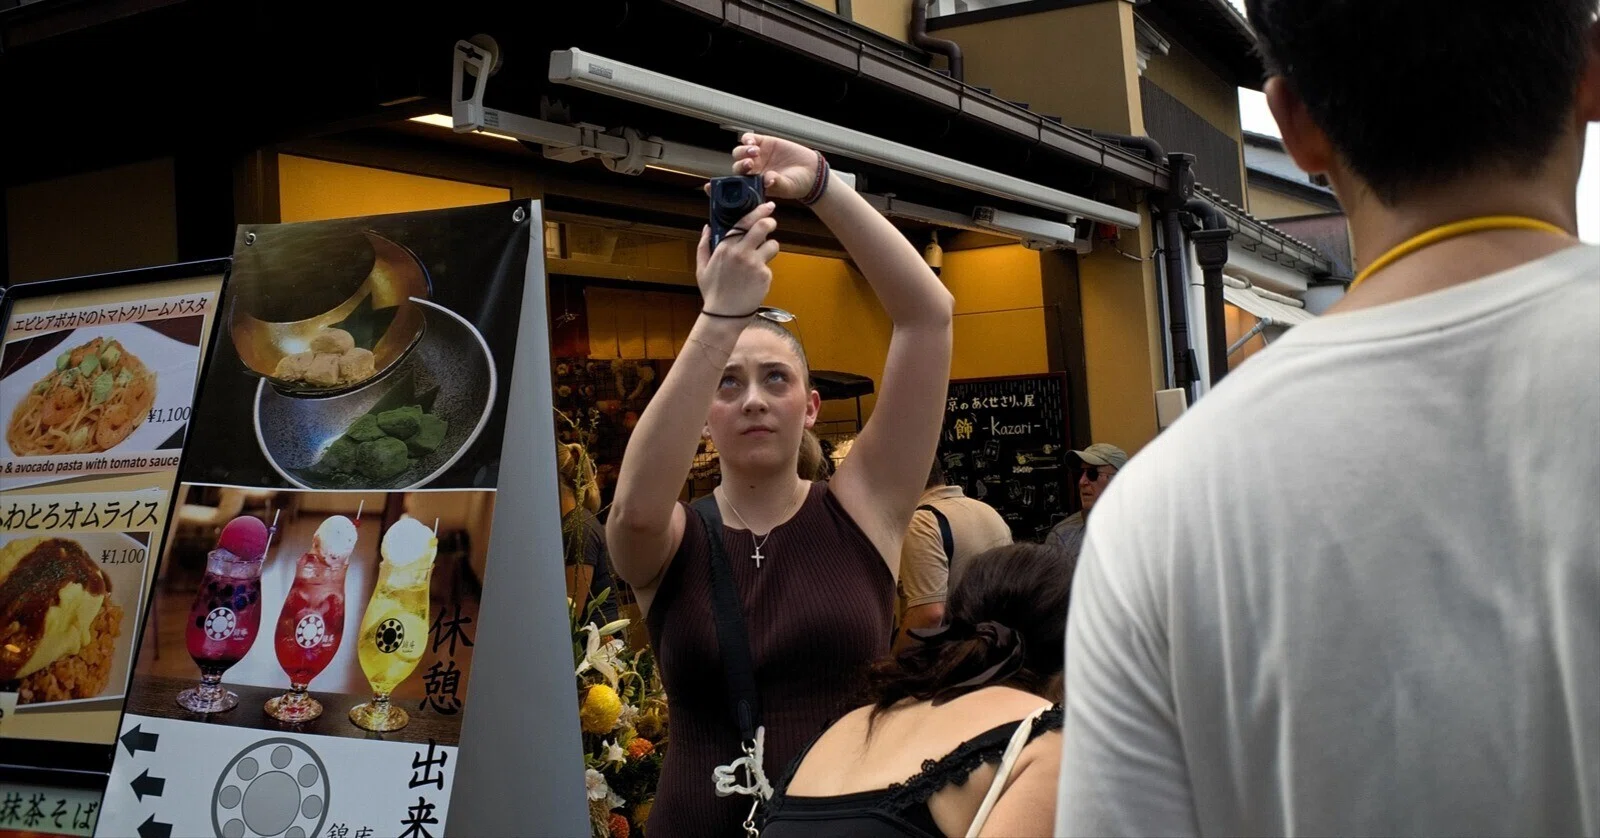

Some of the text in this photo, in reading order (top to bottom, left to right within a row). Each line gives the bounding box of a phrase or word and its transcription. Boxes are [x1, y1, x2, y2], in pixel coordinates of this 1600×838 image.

[13, 297, 208, 332] エビとアボカドのトマトクリームパスタ
[147, 406, 191, 424] ¥1,100
[954, 418, 973, 440] 飾
[5, 461, 13, 474] &
[15, 460, 54, 474] avocado
[55, 460, 83, 474] pasta
[85, 457, 108, 470] with
[110, 457, 147, 469] tomato
[149, 455, 179, 467] sauce
[101, 548, 145, 565] ¥1,100
[0, 791, 98, 830] 抹茶そば
